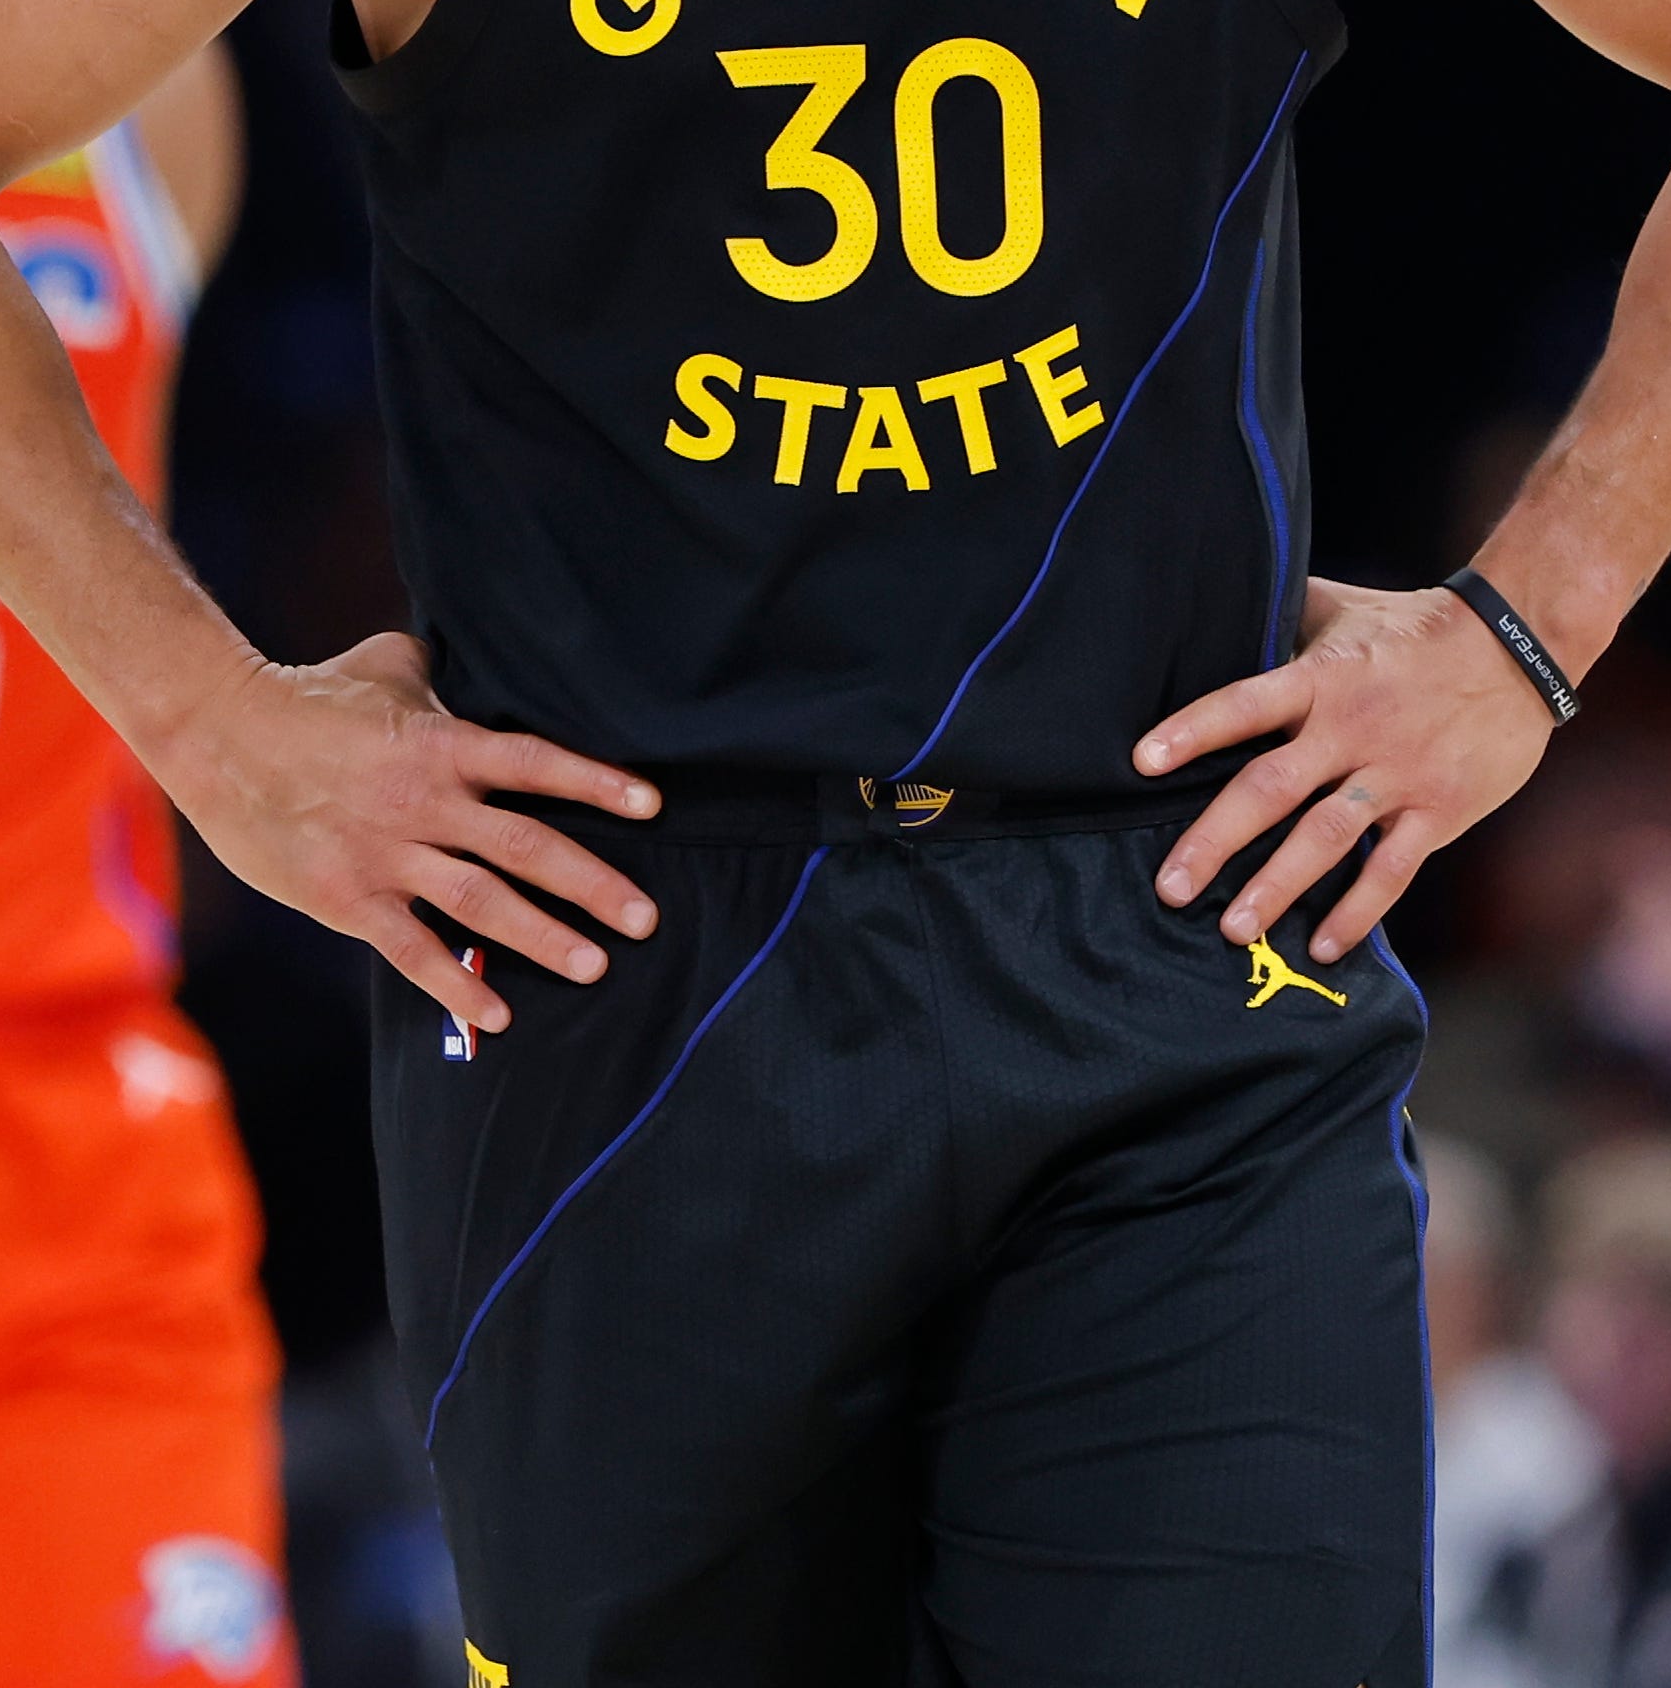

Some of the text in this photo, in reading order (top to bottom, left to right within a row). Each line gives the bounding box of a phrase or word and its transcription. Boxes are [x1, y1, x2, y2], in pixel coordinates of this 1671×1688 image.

[715, 37, 1044, 303] 30
[664, 324, 1105, 494] STATE
[1498, 614, 1541, 664] FEAR
[1534, 658, 1560, 691] OVER
[444, 1035, 464, 1056] NBA
